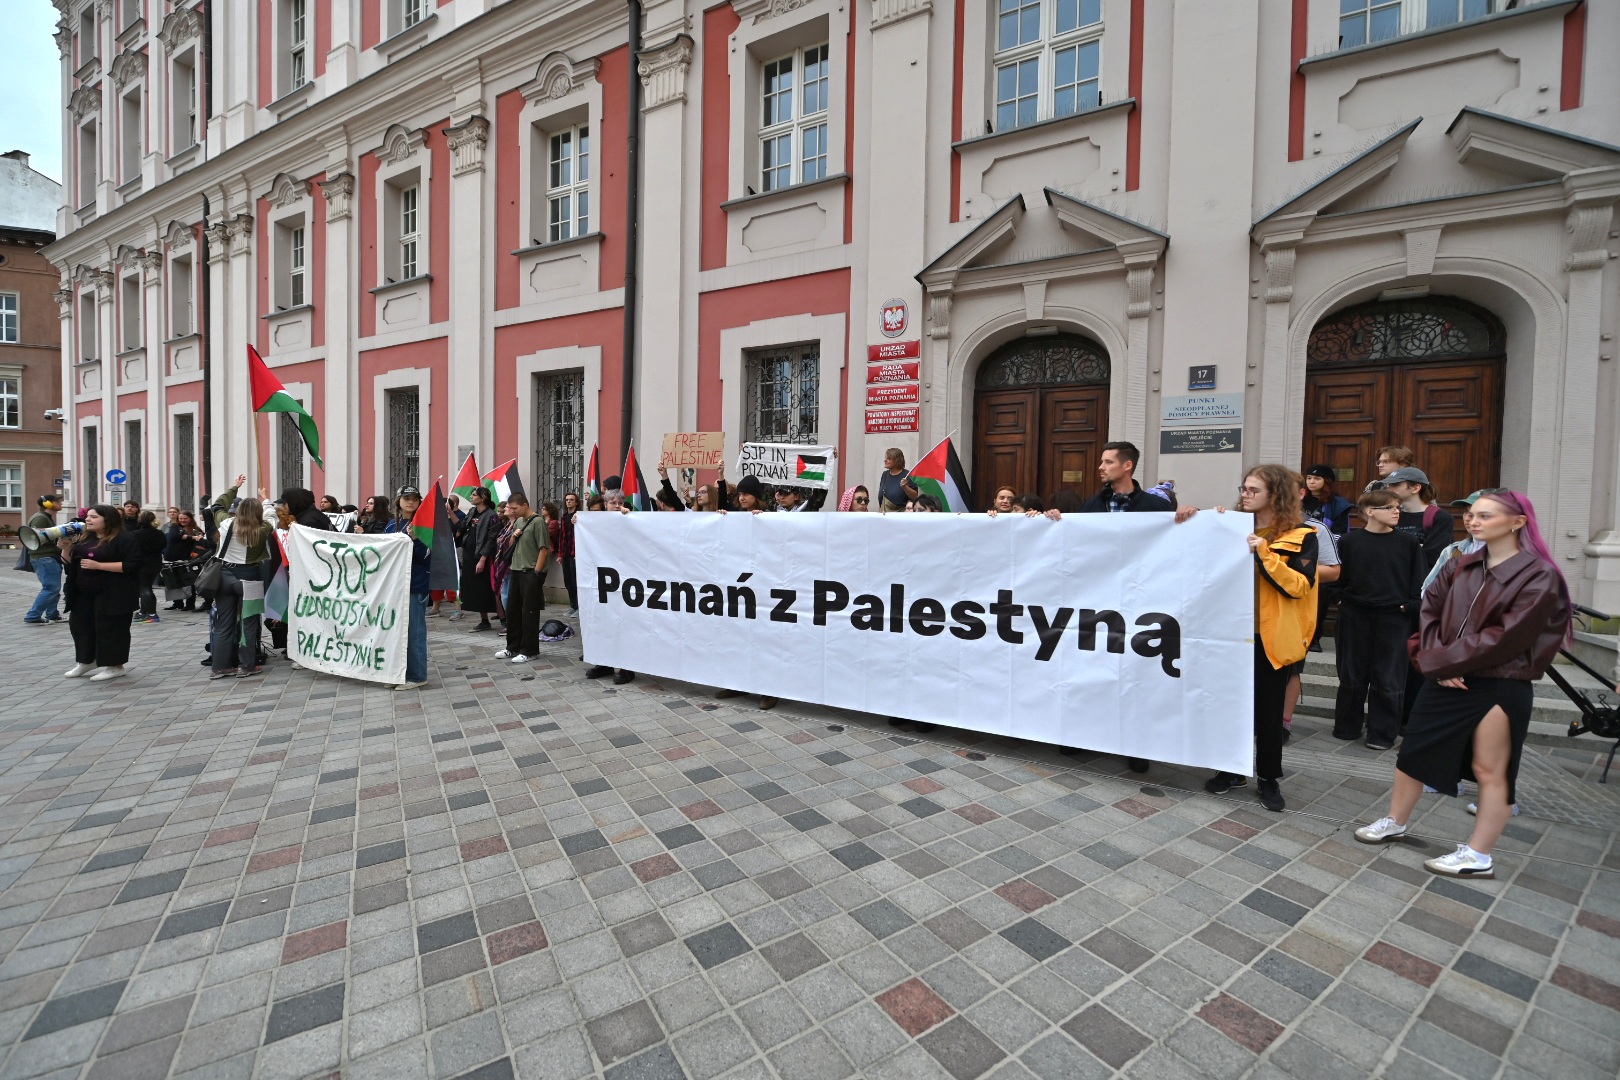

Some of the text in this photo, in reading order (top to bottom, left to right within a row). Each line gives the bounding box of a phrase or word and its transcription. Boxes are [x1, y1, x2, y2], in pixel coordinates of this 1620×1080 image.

[880, 350, 906, 358] MIASTA
[873, 374, 911, 382] POZNANIA
[880, 369, 906, 377] MIASTA
[1197, 369, 1208, 379] 17
[674, 433, 708, 449] FREE
[662, 450, 722, 467] PALESTINE
[742, 446, 786, 463] SJP IN
[742, 463, 788, 480] POZNAŃ
[309, 540, 381, 594] STOP
[597, 566, 1181, 678] Poznań z Palestyną
[334, 625, 346, 641] W
[297, 630, 385, 671] PALESTYNIE
